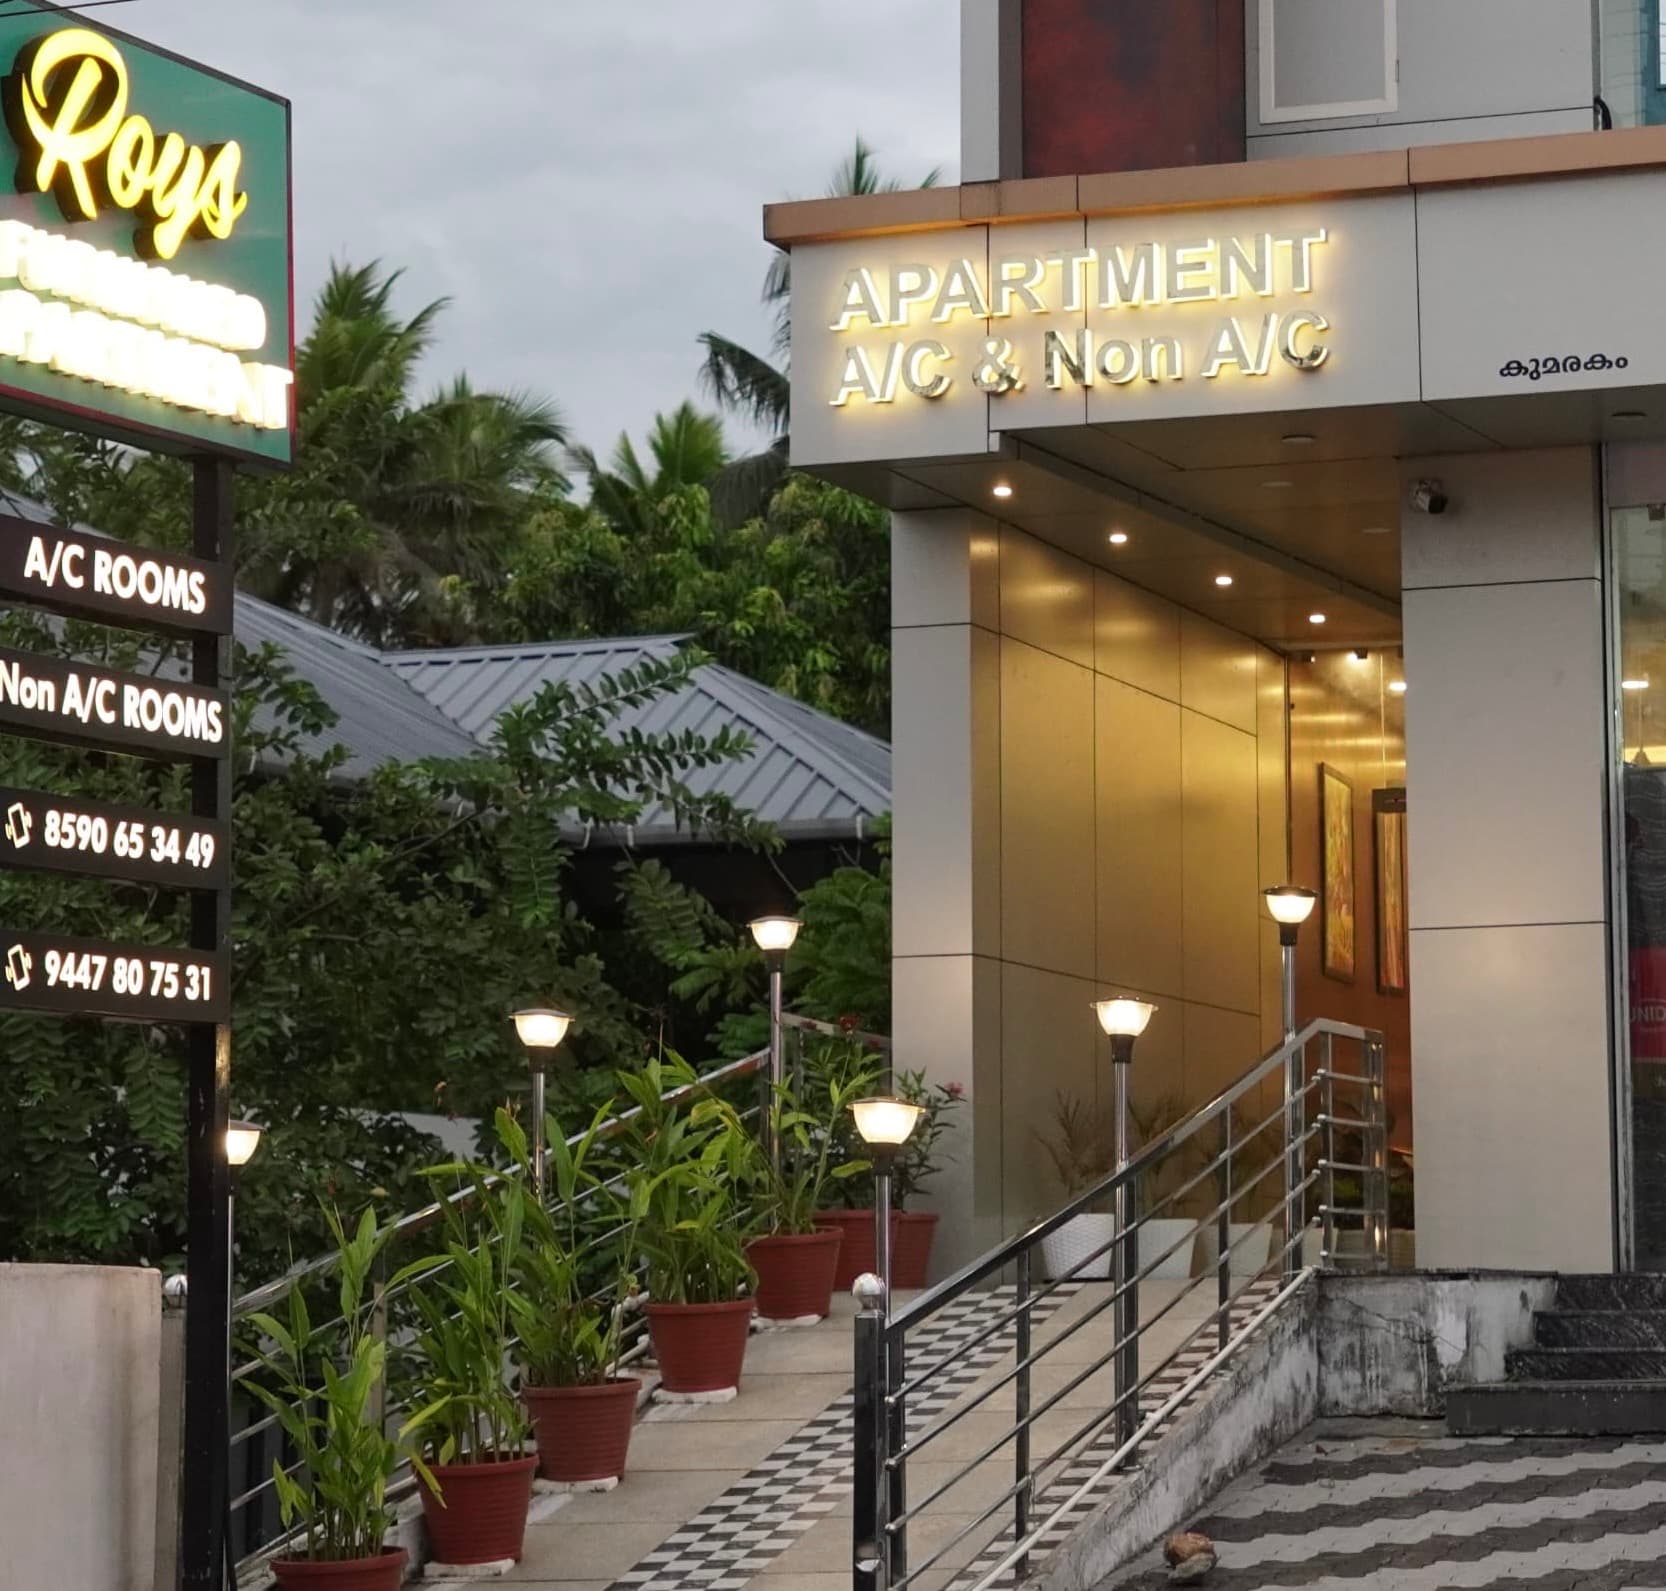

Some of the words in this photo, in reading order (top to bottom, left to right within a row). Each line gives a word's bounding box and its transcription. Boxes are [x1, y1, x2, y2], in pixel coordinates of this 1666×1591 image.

[22, 28, 248, 260] Roys
[830, 227, 1329, 331] APARTMENT
[829, 338, 953, 407] A/C
[971, 335, 1025, 393] &
[1044, 327, 1183, 389] Non
[1201, 309, 1330, 378] A/C
[1499, 353, 1629, 381] കുമരകം
[23, 536, 85, 588] A/C
[93, 549, 206, 615] ROOMS
[0, 659, 55, 713] Non
[61, 673, 116, 724] A/C
[123, 684, 223, 744] ROOMS
[44, 810, 107, 854] 8590
[113, 820, 144, 860] 65
[150, 826, 181, 864] 34
[185, 832, 215, 869] 49
[44, 950, 107, 991] 9447
[112, 958, 144, 998] 80
[149, 962, 180, 1000] 75
[184, 966, 211, 1001] 31
